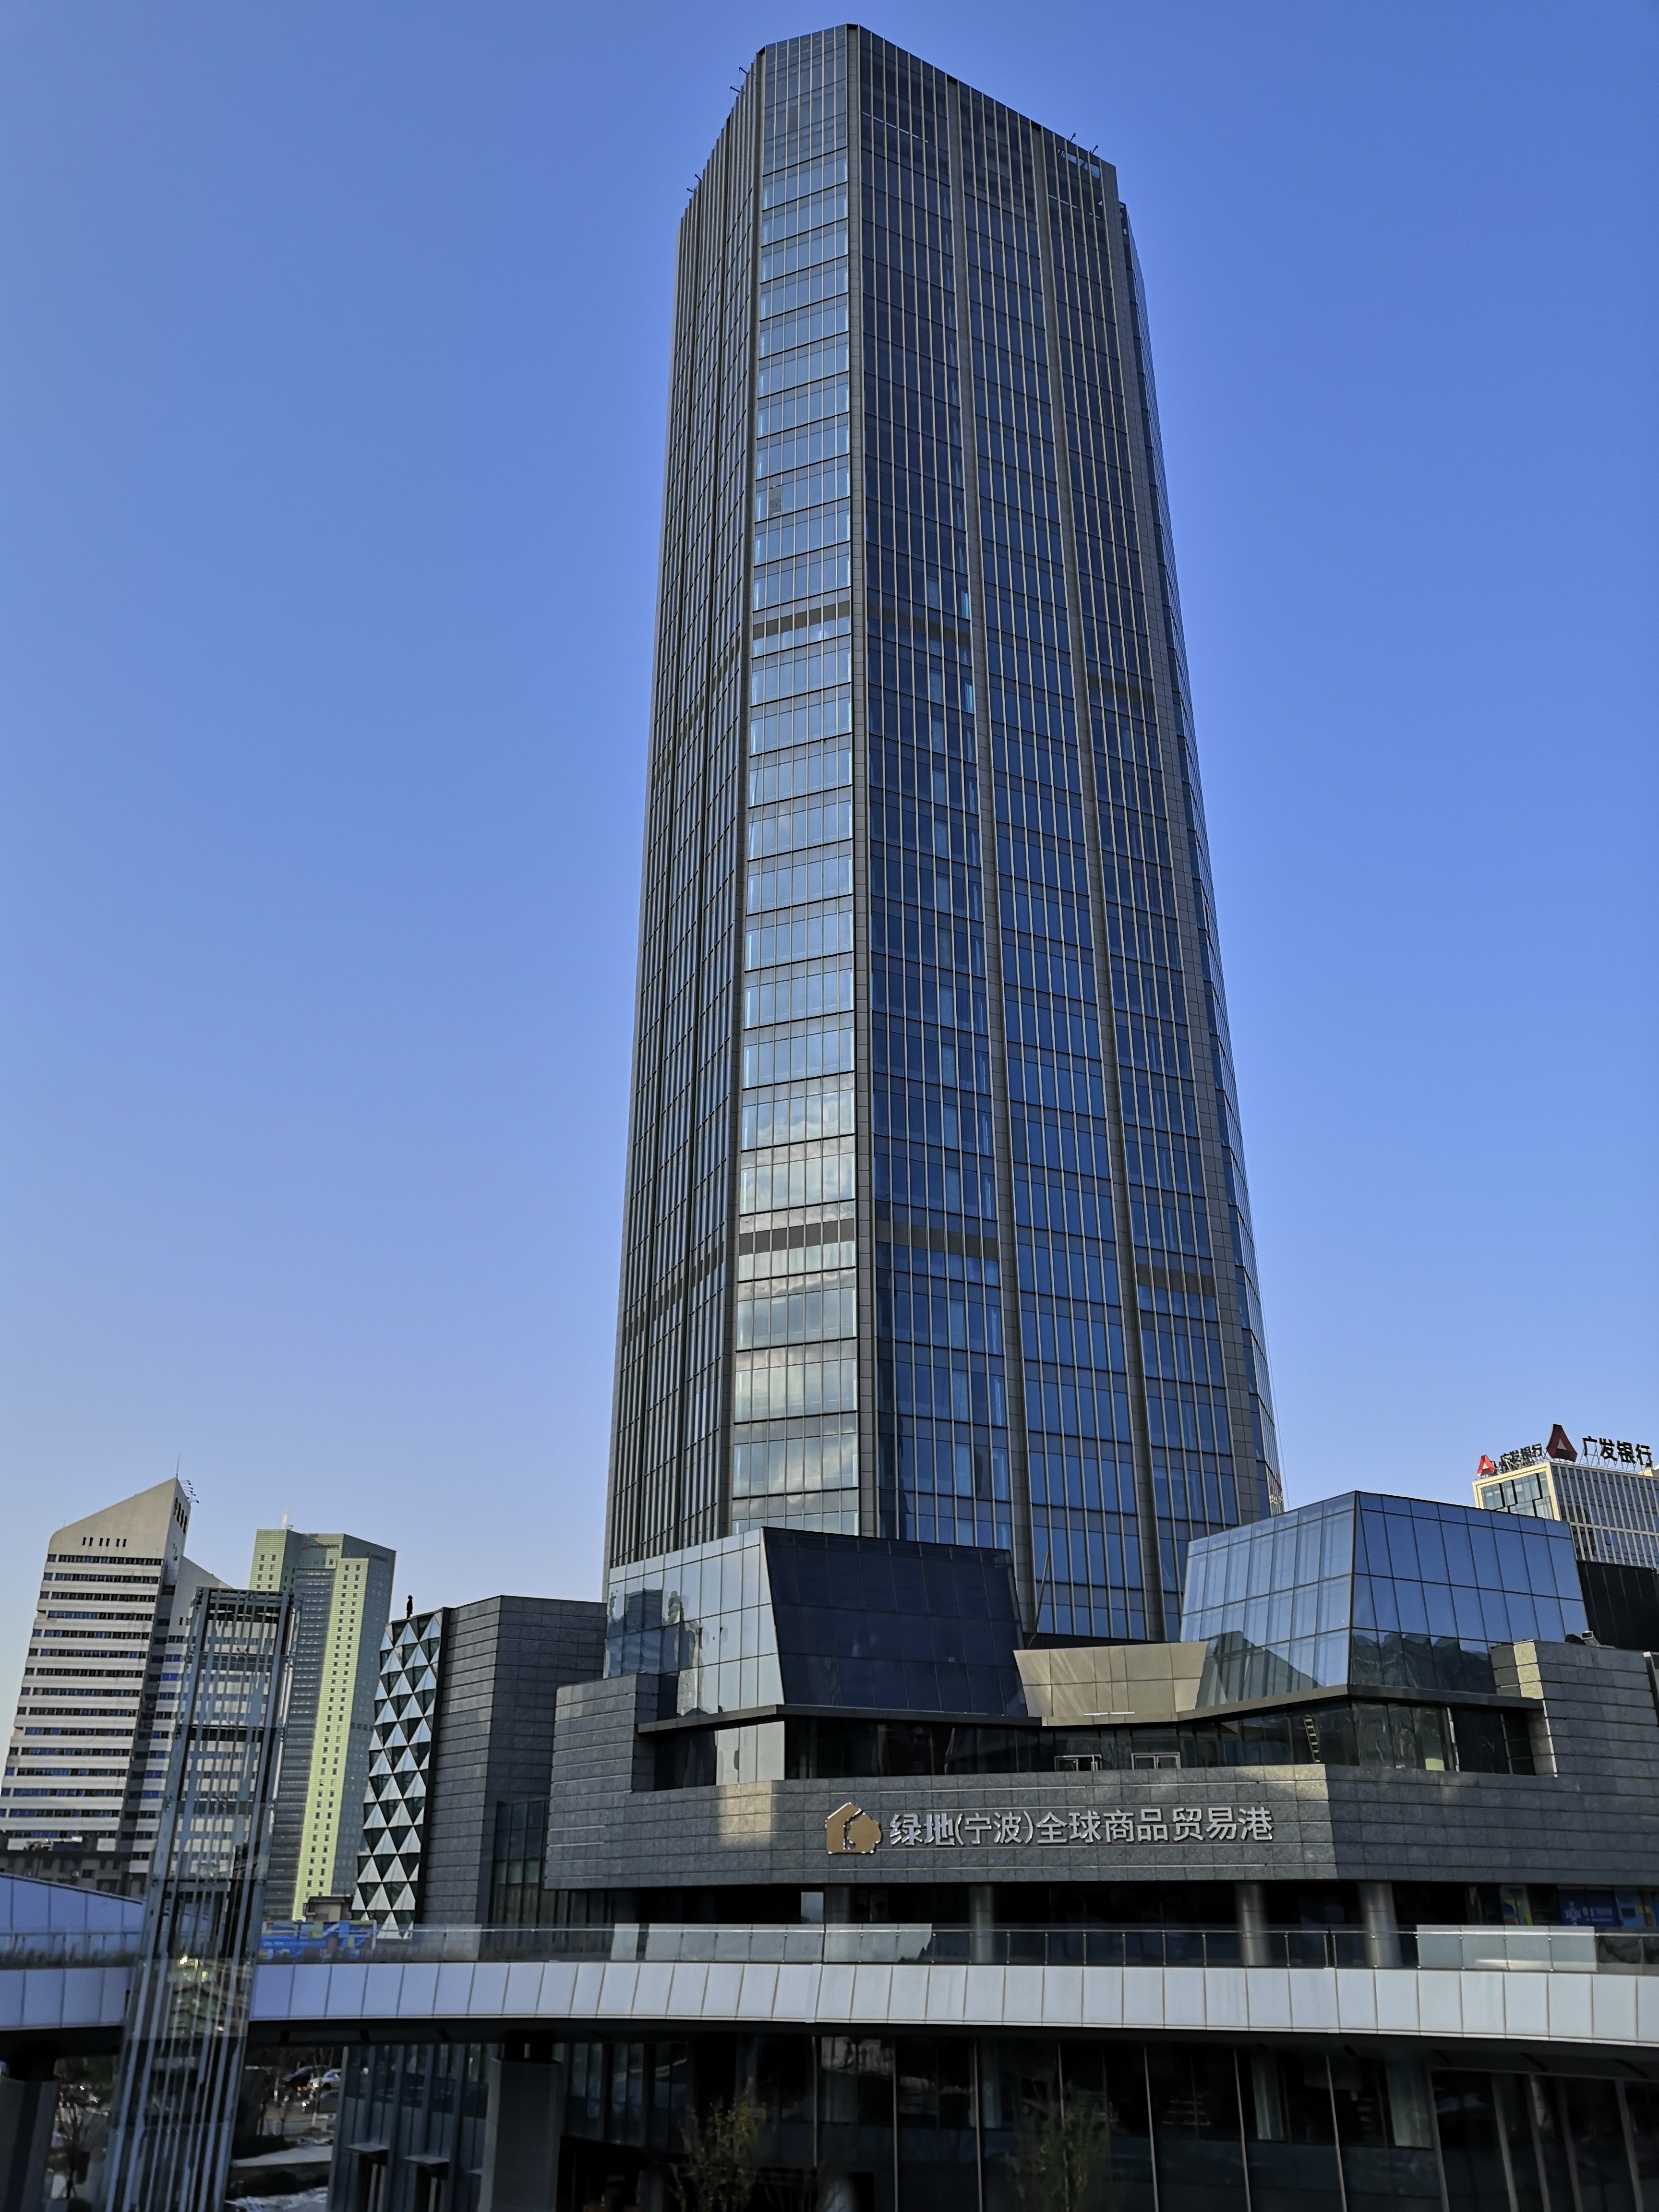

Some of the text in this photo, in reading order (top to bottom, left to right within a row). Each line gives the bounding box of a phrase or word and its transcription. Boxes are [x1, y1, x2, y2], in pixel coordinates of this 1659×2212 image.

[1582, 1436, 1652, 1467] 广发银行
[890, 1806, 1273, 1846] 绿地(宁波)全球商品贸易港
